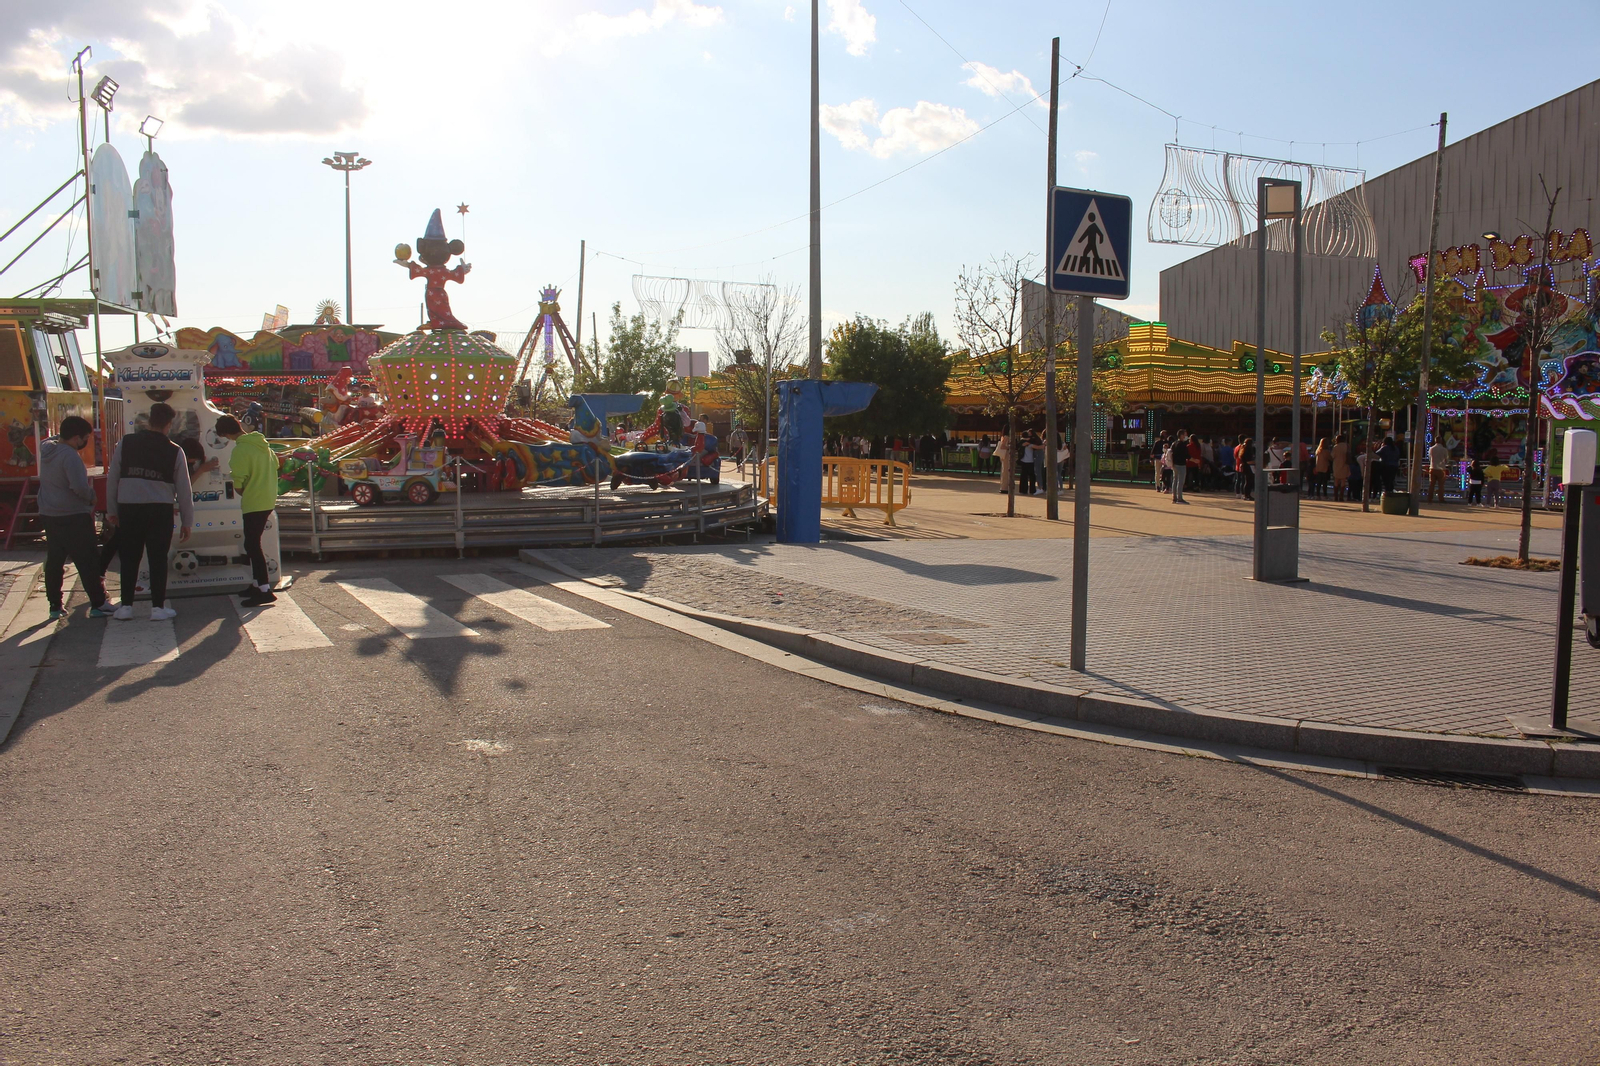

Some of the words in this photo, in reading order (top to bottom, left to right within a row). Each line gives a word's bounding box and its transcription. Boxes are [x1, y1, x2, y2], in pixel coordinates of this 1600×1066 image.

[1489, 234, 1534, 271] DE
[1548, 228, 1593, 262] LA
[117, 366, 193, 382] Kickboxer
[128, 467, 144, 476] JUST
[145, 468, 156, 478] DO
